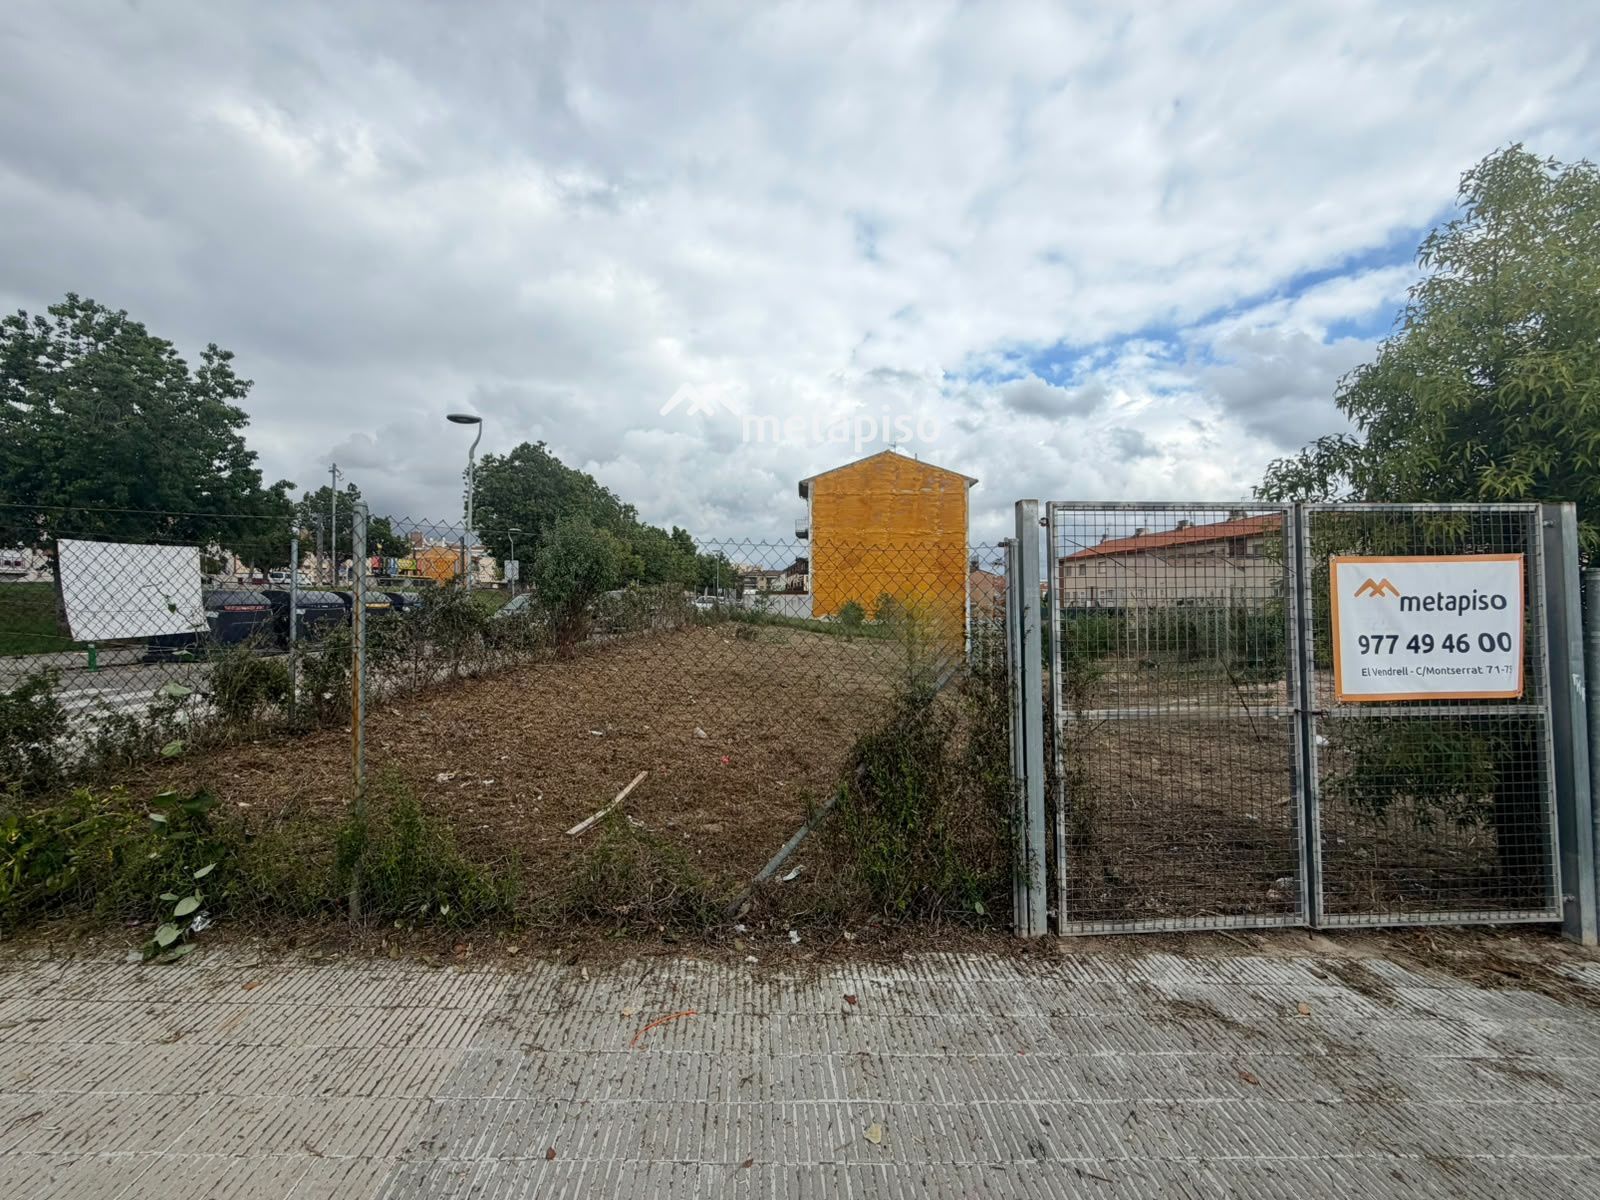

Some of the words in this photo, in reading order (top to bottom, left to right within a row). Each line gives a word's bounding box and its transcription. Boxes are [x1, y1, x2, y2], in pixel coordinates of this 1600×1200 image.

[1400, 589, 1507, 616] metapiso
[1358, 634, 1399, 654] 977
[1406, 634, 1435, 654] 49
[1441, 633, 1470, 653] 46
[1478, 632, 1512, 653] 00
[1361, 667, 1371, 677] El
[1372, 666, 1409, 677] Vendrell
[1415, 665, 1484, 677] C/Montserrat
